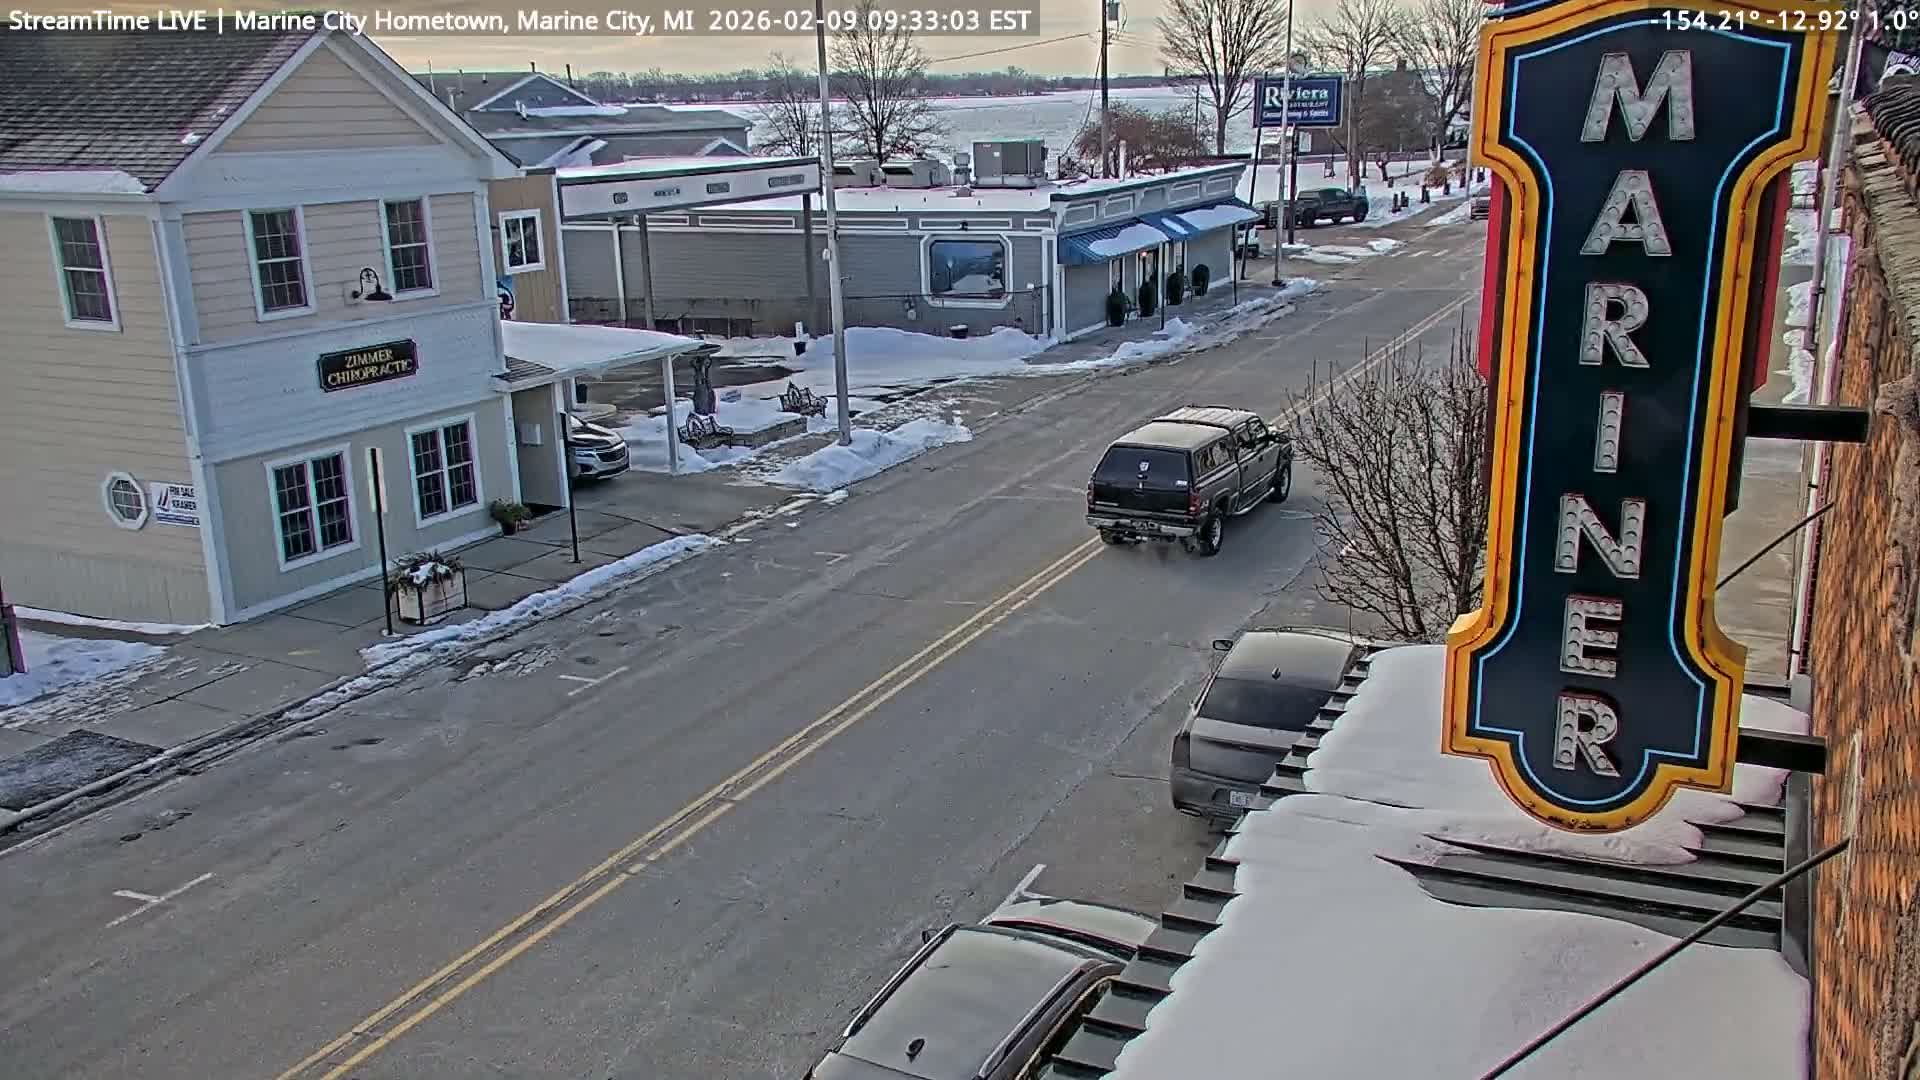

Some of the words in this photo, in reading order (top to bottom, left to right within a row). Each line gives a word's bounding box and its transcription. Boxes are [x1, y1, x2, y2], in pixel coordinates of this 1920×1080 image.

[344, 349, 394, 368] ZIMMER
[327, 359, 413, 386] CHIROPRACTIC
[1553, 50, 1696, 777] MARINER
